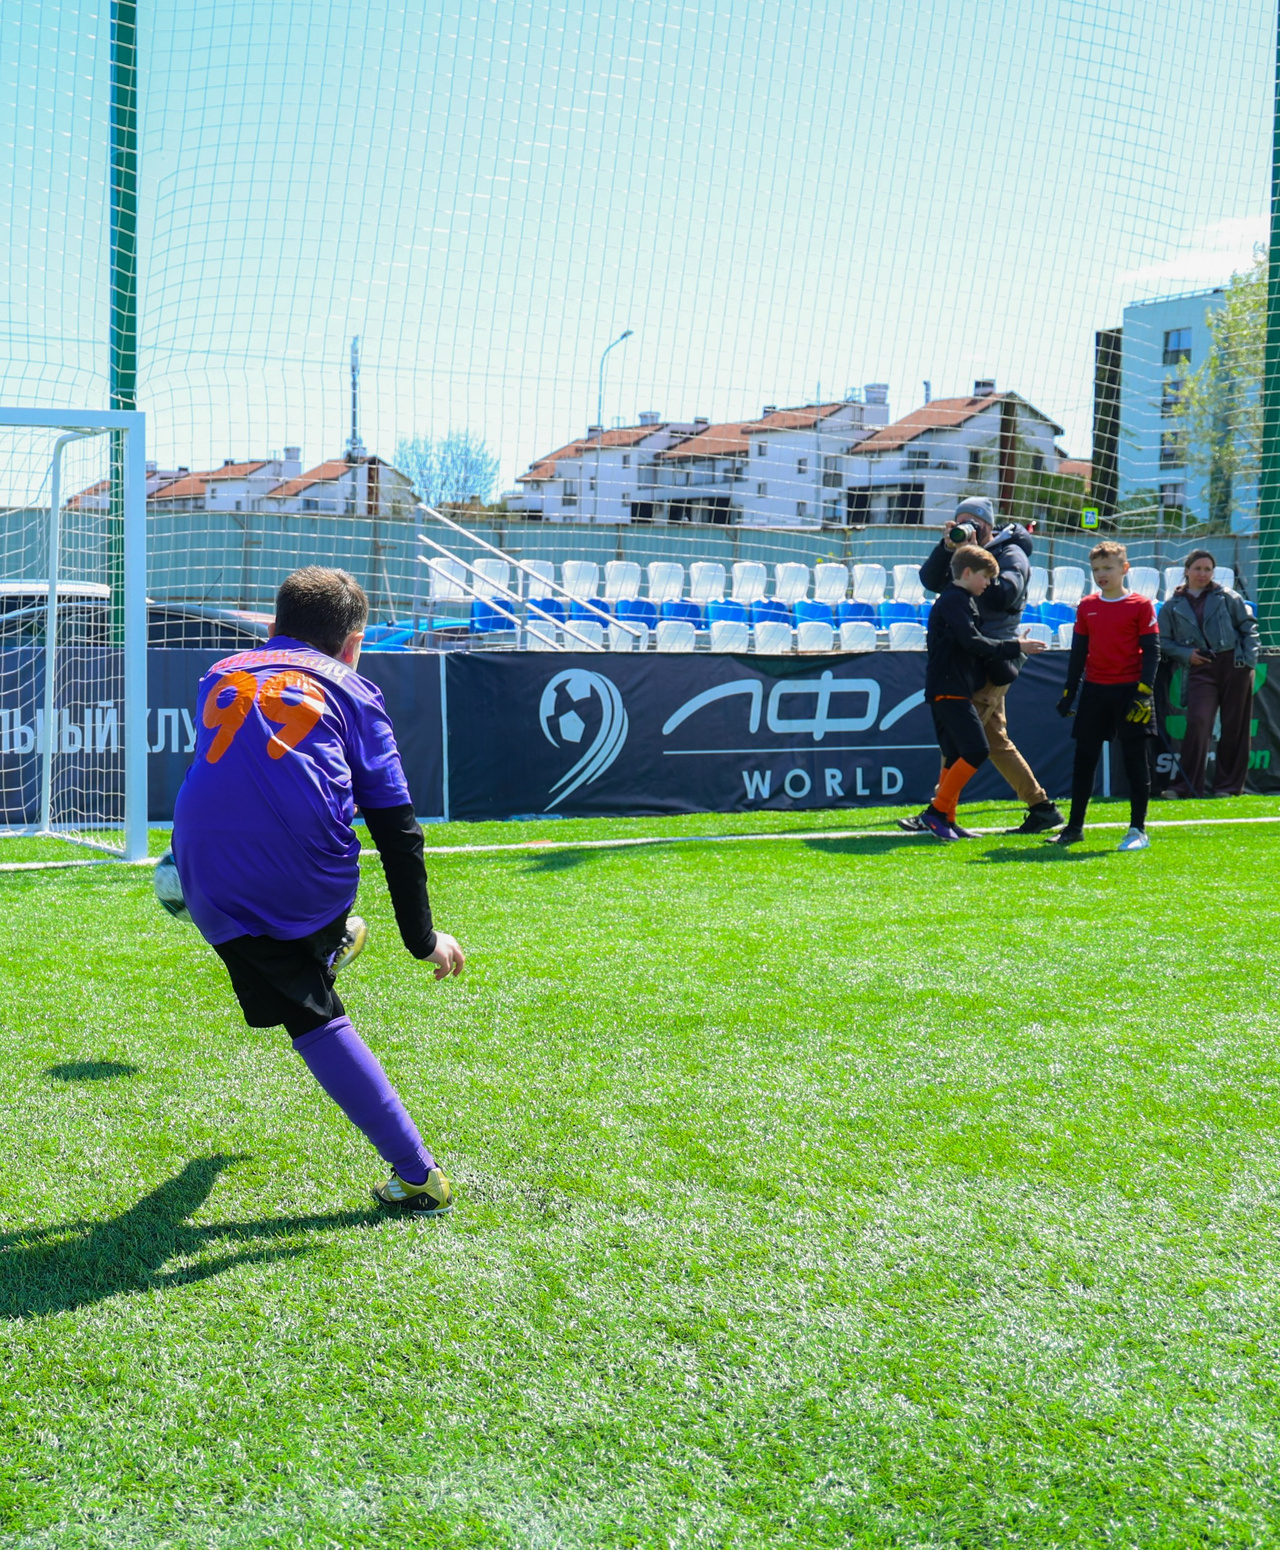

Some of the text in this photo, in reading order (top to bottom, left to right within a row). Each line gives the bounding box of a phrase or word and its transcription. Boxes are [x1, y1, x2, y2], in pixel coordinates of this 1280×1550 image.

[146, 708, 198, 753] ЛУ
[202, 670, 326, 764] 99
[742, 766, 904, 799] WORLD
